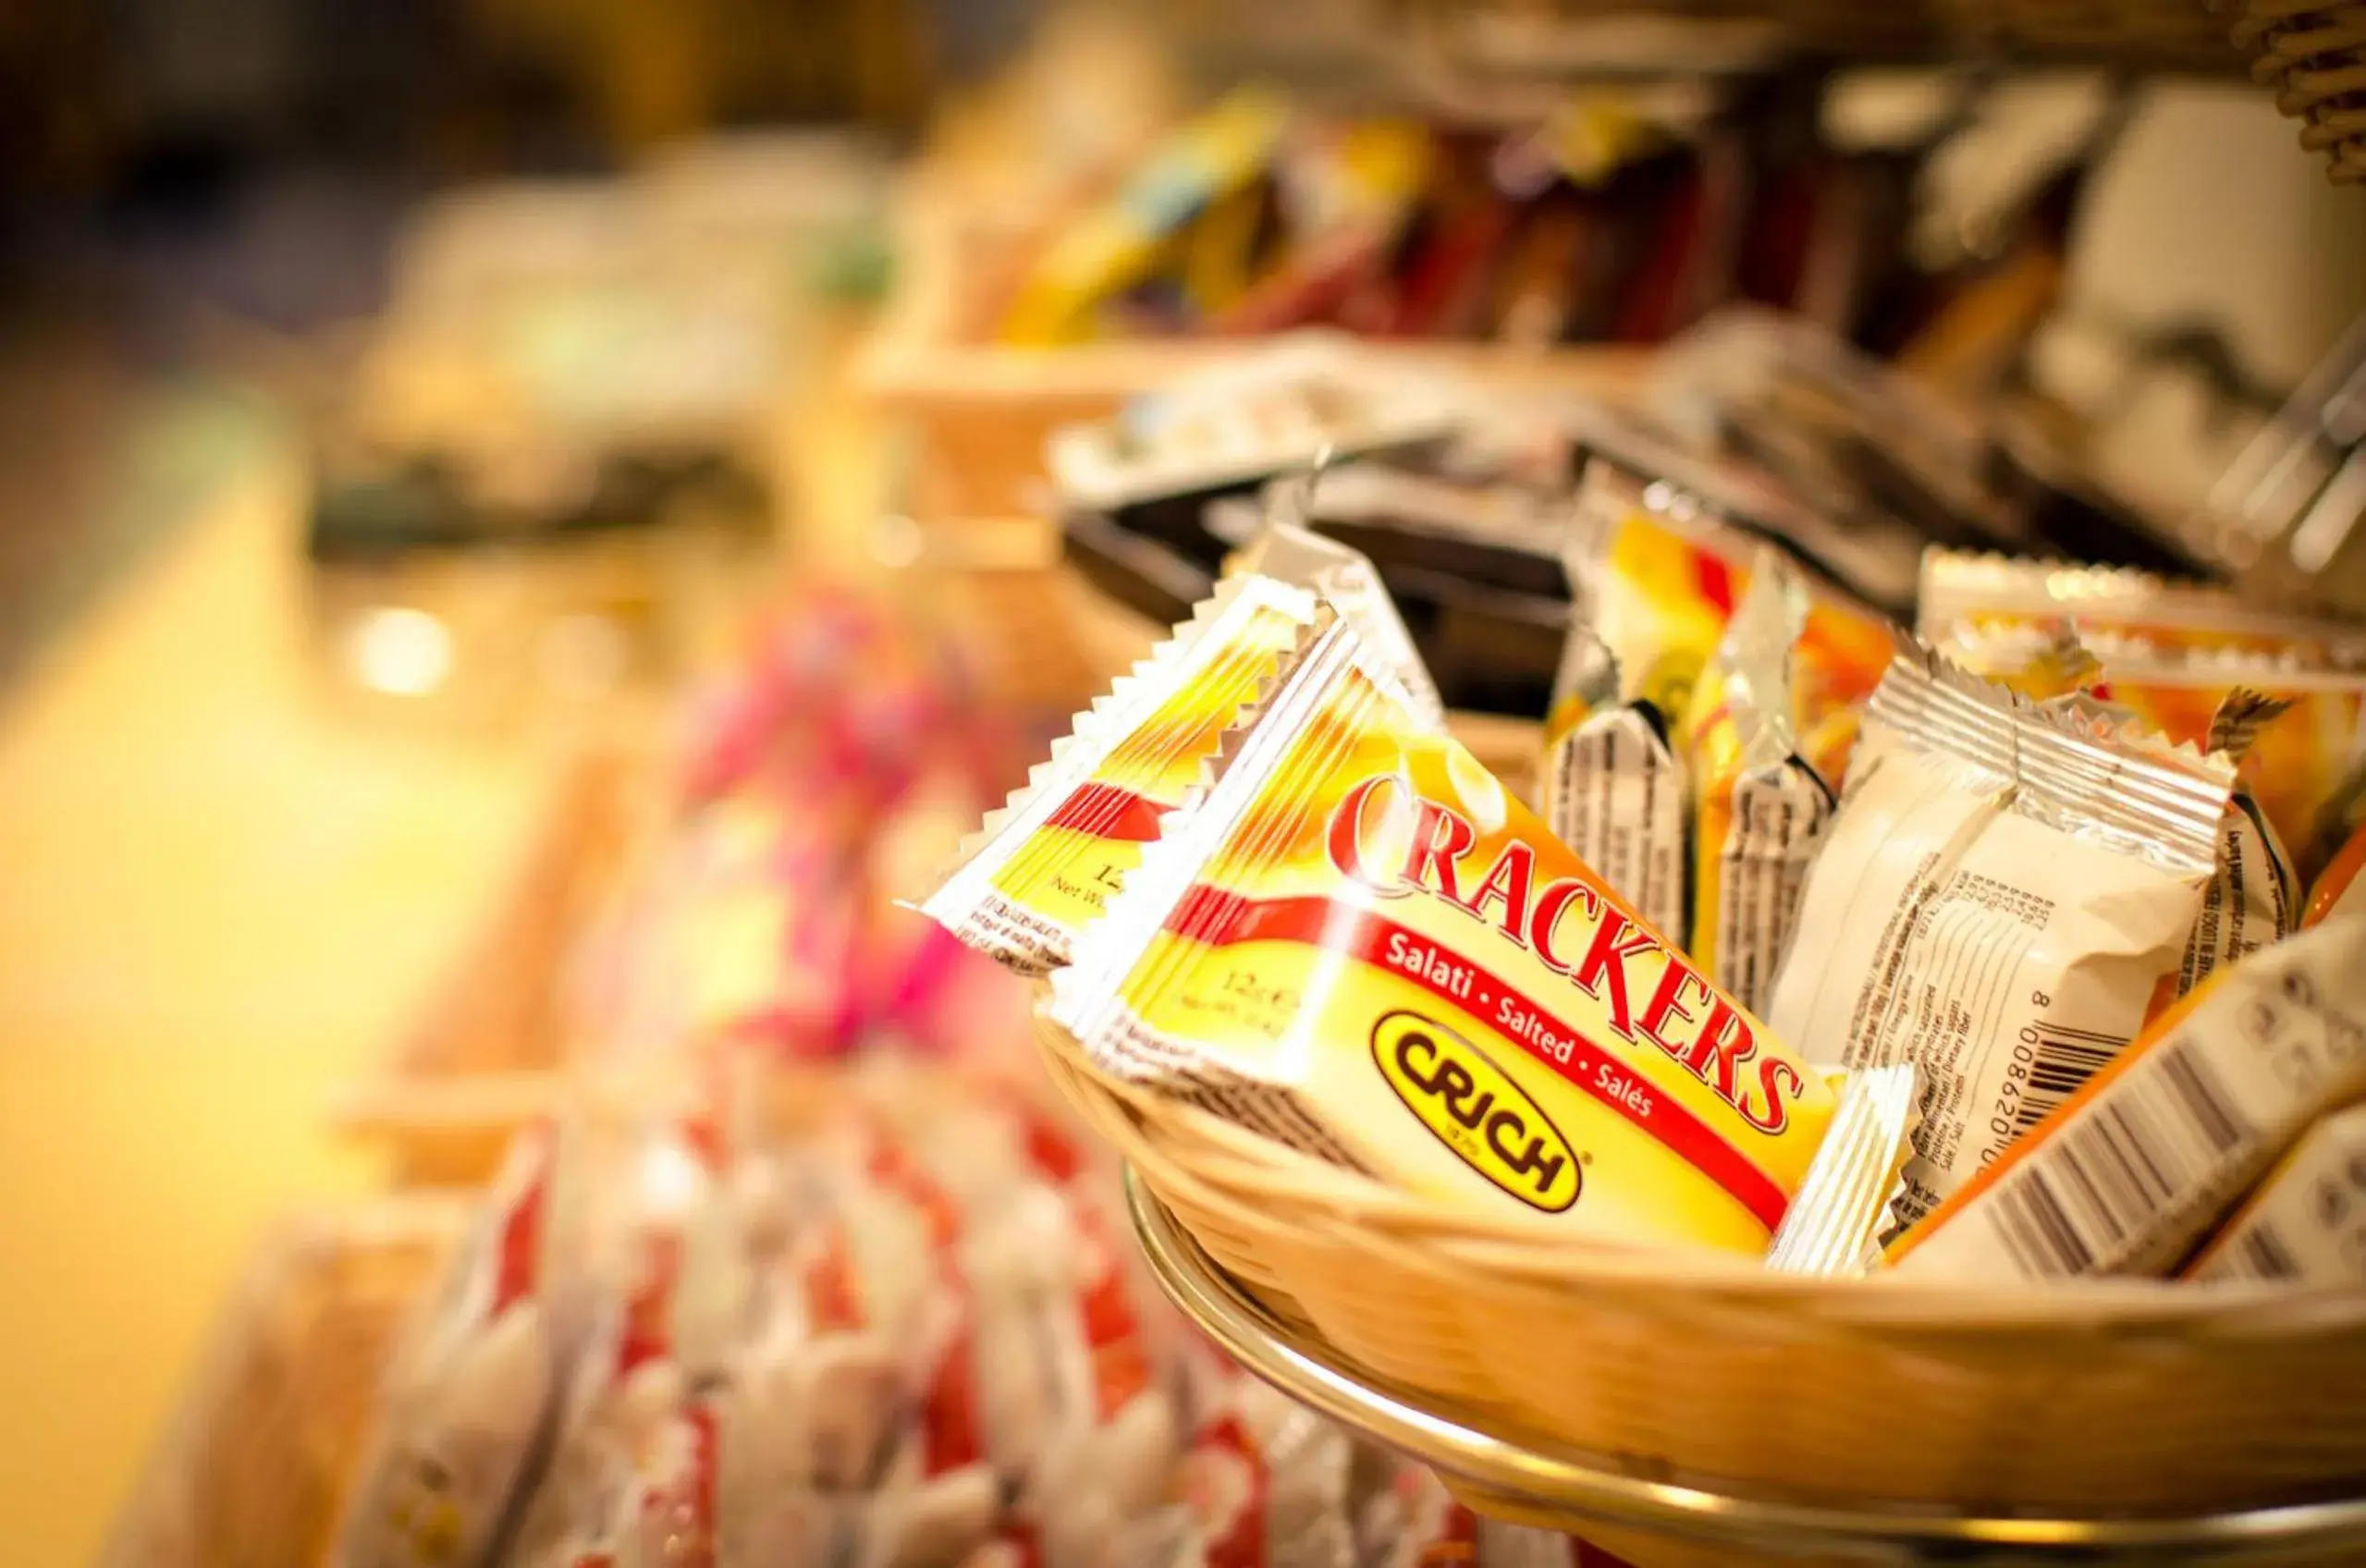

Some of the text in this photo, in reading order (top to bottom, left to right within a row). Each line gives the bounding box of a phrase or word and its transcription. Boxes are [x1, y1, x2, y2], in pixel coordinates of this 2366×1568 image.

[1327, 776, 1805, 1135] CRACKERS
[1918, 985, 1936, 1032] saturated
[2030, 989, 2052, 1008] 8
[1385, 934, 1654, 1119] Salati Salted Salés
[1932, 1032, 1950, 1061] which
[1943, 1037, 1966, 1072] Dietary
[1989, 1027, 2039, 1135] 008620
[1394, 1030, 1566, 1194] CRICH
[1949, 1121, 1965, 1142] Salt
[1928, 1121, 1949, 1164] Proteine
